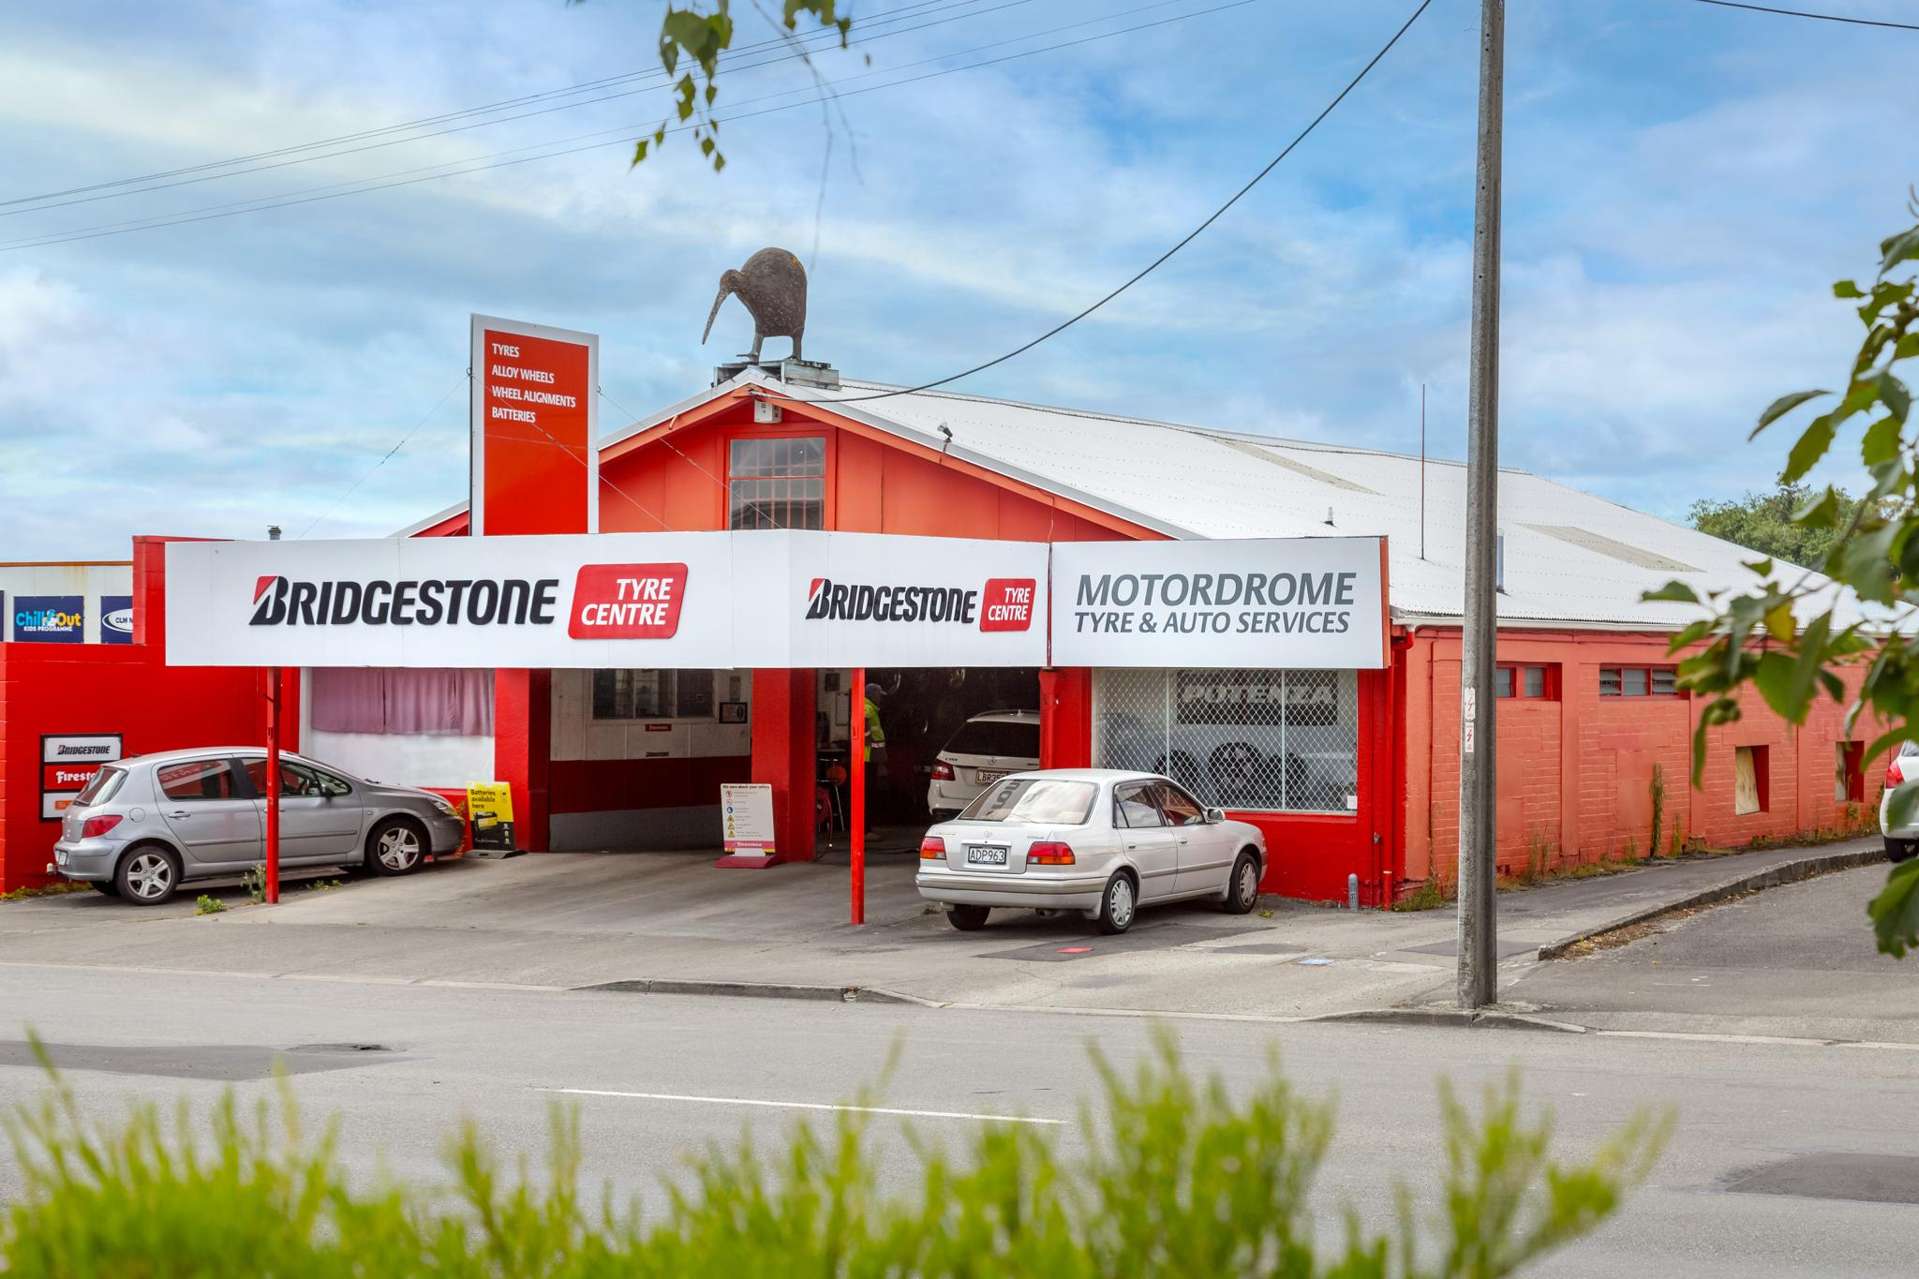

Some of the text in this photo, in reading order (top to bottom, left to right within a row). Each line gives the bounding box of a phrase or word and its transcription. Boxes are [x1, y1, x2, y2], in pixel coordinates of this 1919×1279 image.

[492, 343, 520, 358] TYRES
[492, 364, 555, 384] ALLOY WHEELS
[492, 385, 576, 408] WHEEL ALIGNMENTS
[492, 407, 536, 423] BATTERIES
[616, 578, 673, 601] TYRE
[1004, 587, 1031, 603] TYRE
[1076, 572, 1357, 607] MOTORDROME
[249, 576, 559, 626] BRIDGESTONE
[805, 578, 977, 624] BRIDGESTONE
[58, 612, 82, 627] Out
[581, 603, 668, 626] CENTRE
[988, 605, 1028, 621] CENTRE
[1074, 612, 1351, 634] TYRE & AUTO SERVICES
[57, 744, 111, 755] BRIDGESTONE
[970, 849, 1005, 861] ADP963
